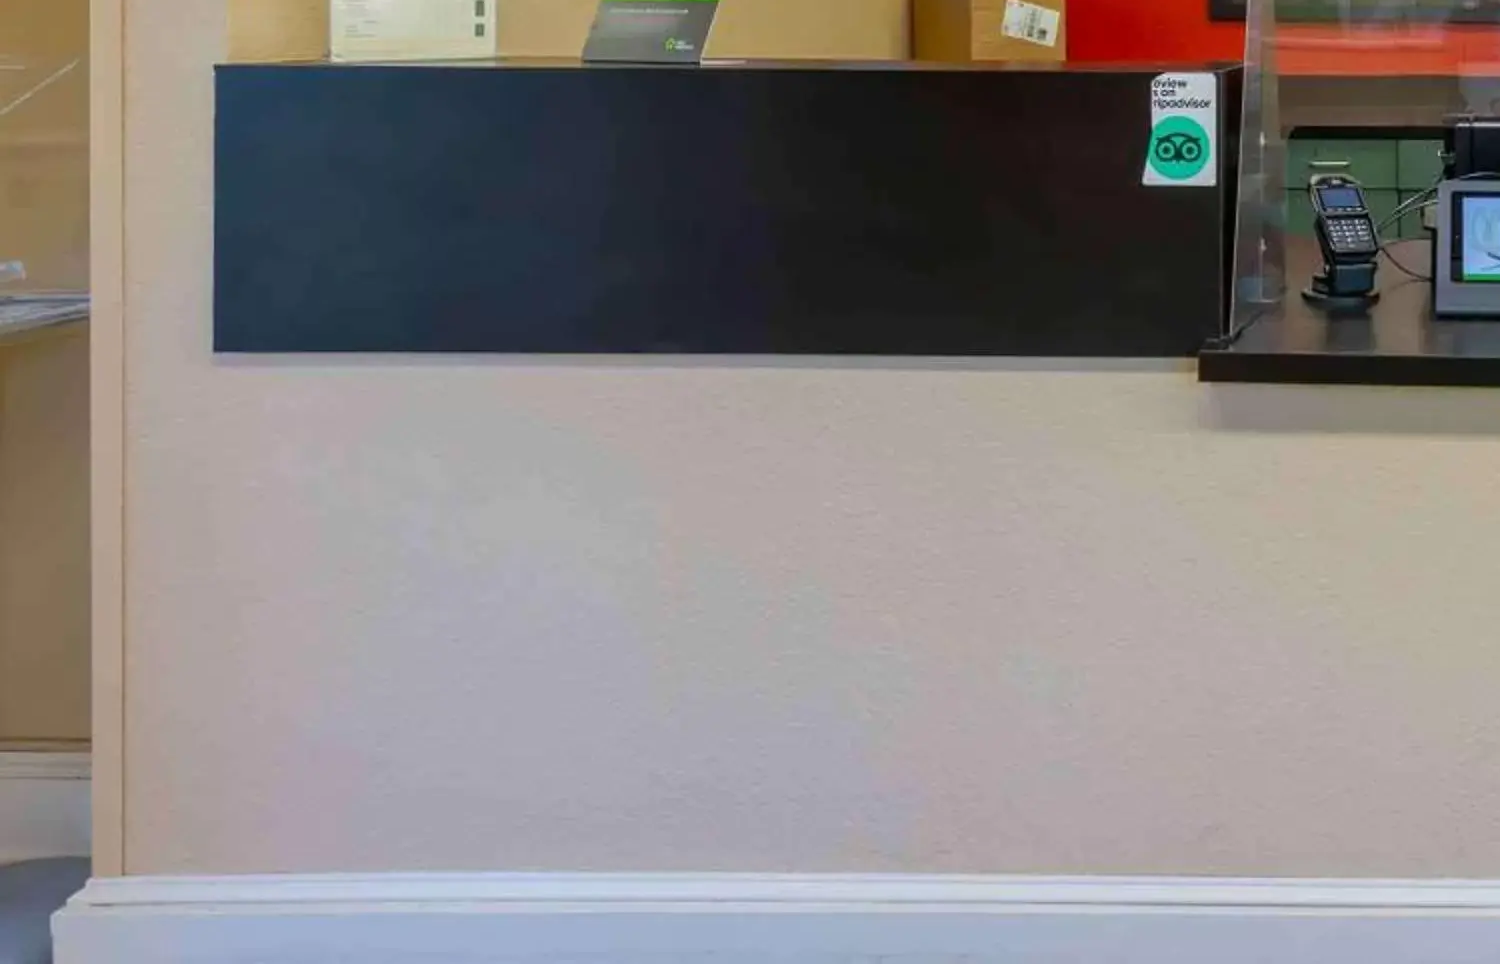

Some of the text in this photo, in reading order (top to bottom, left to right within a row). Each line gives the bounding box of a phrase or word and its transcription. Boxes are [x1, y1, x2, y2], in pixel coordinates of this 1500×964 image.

[1153, 77, 1188, 89] eview
[1160, 88, 1177, 97] on
[1153, 97, 1212, 110] ripadvisor
